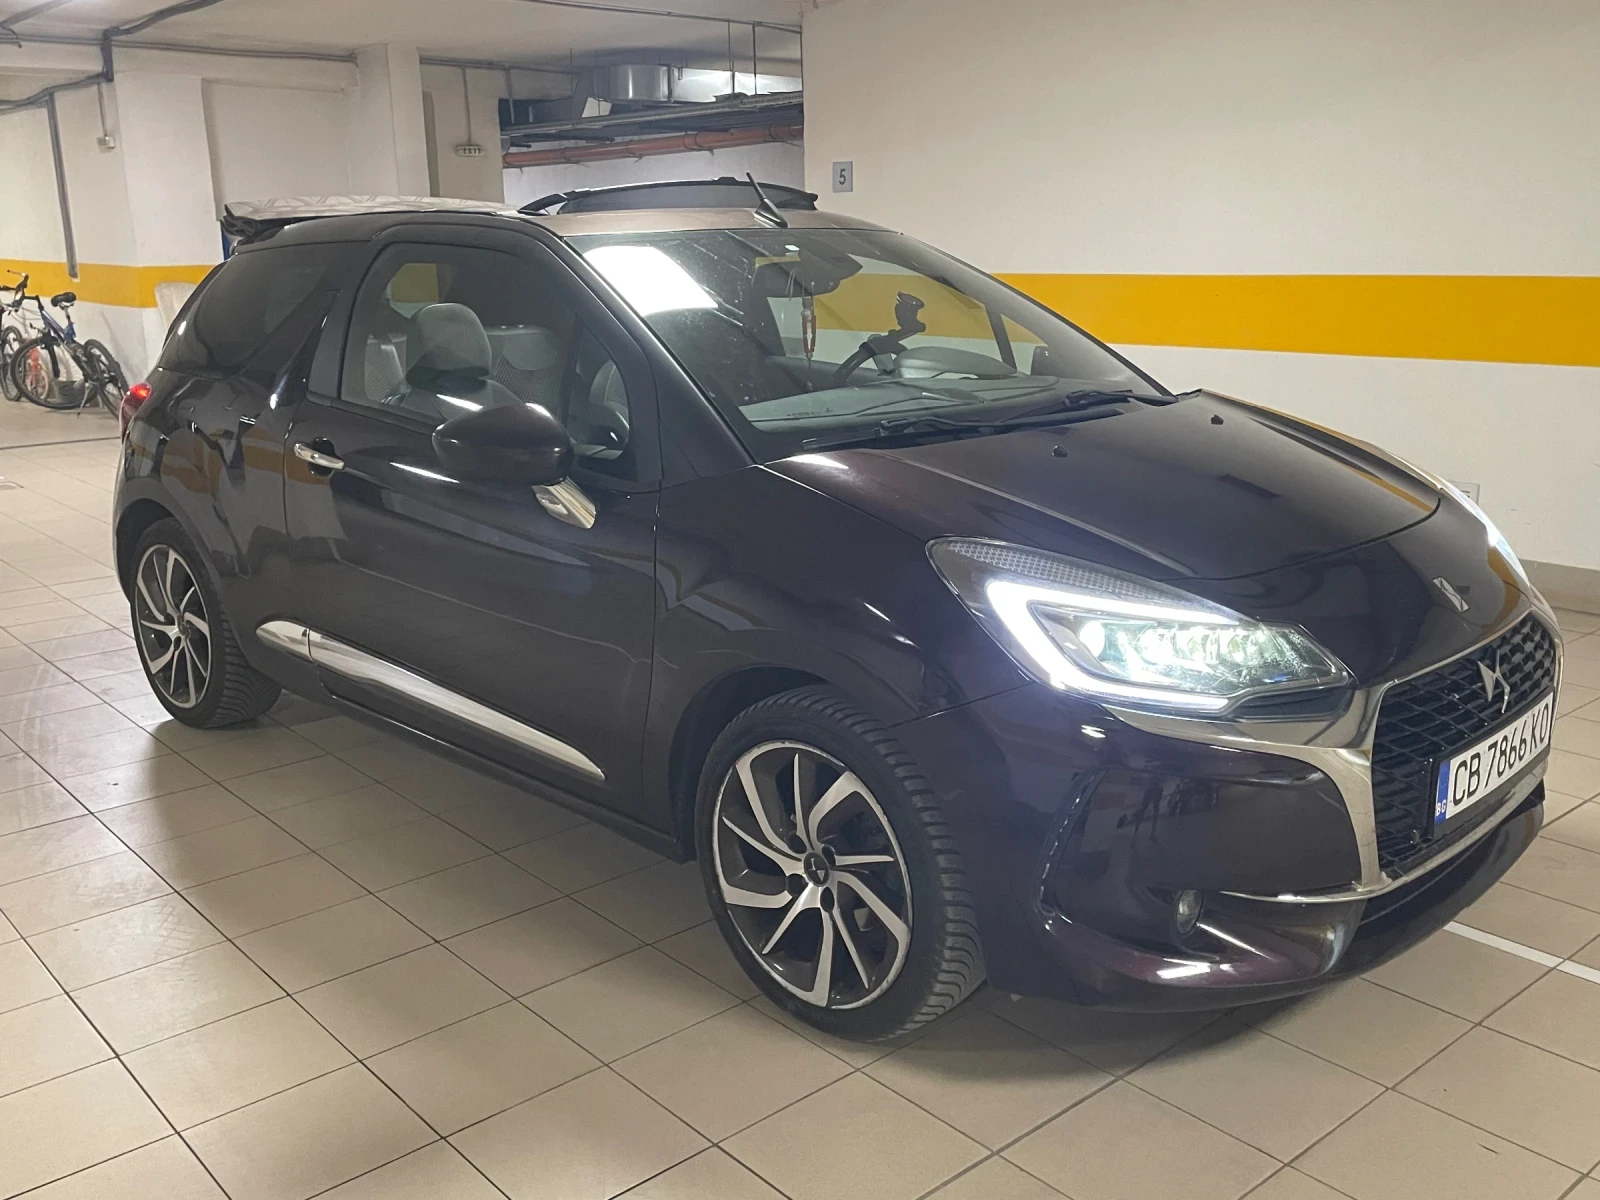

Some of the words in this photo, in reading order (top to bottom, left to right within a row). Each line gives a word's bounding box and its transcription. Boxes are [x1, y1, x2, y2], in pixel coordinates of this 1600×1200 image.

[838, 168, 847, 186] 5
[1453, 752, 1481, 807] CB
[1485, 719, 1527, 789] 7866
[1530, 702, 1549, 755] KO
[1435, 799, 1447, 817] BG
